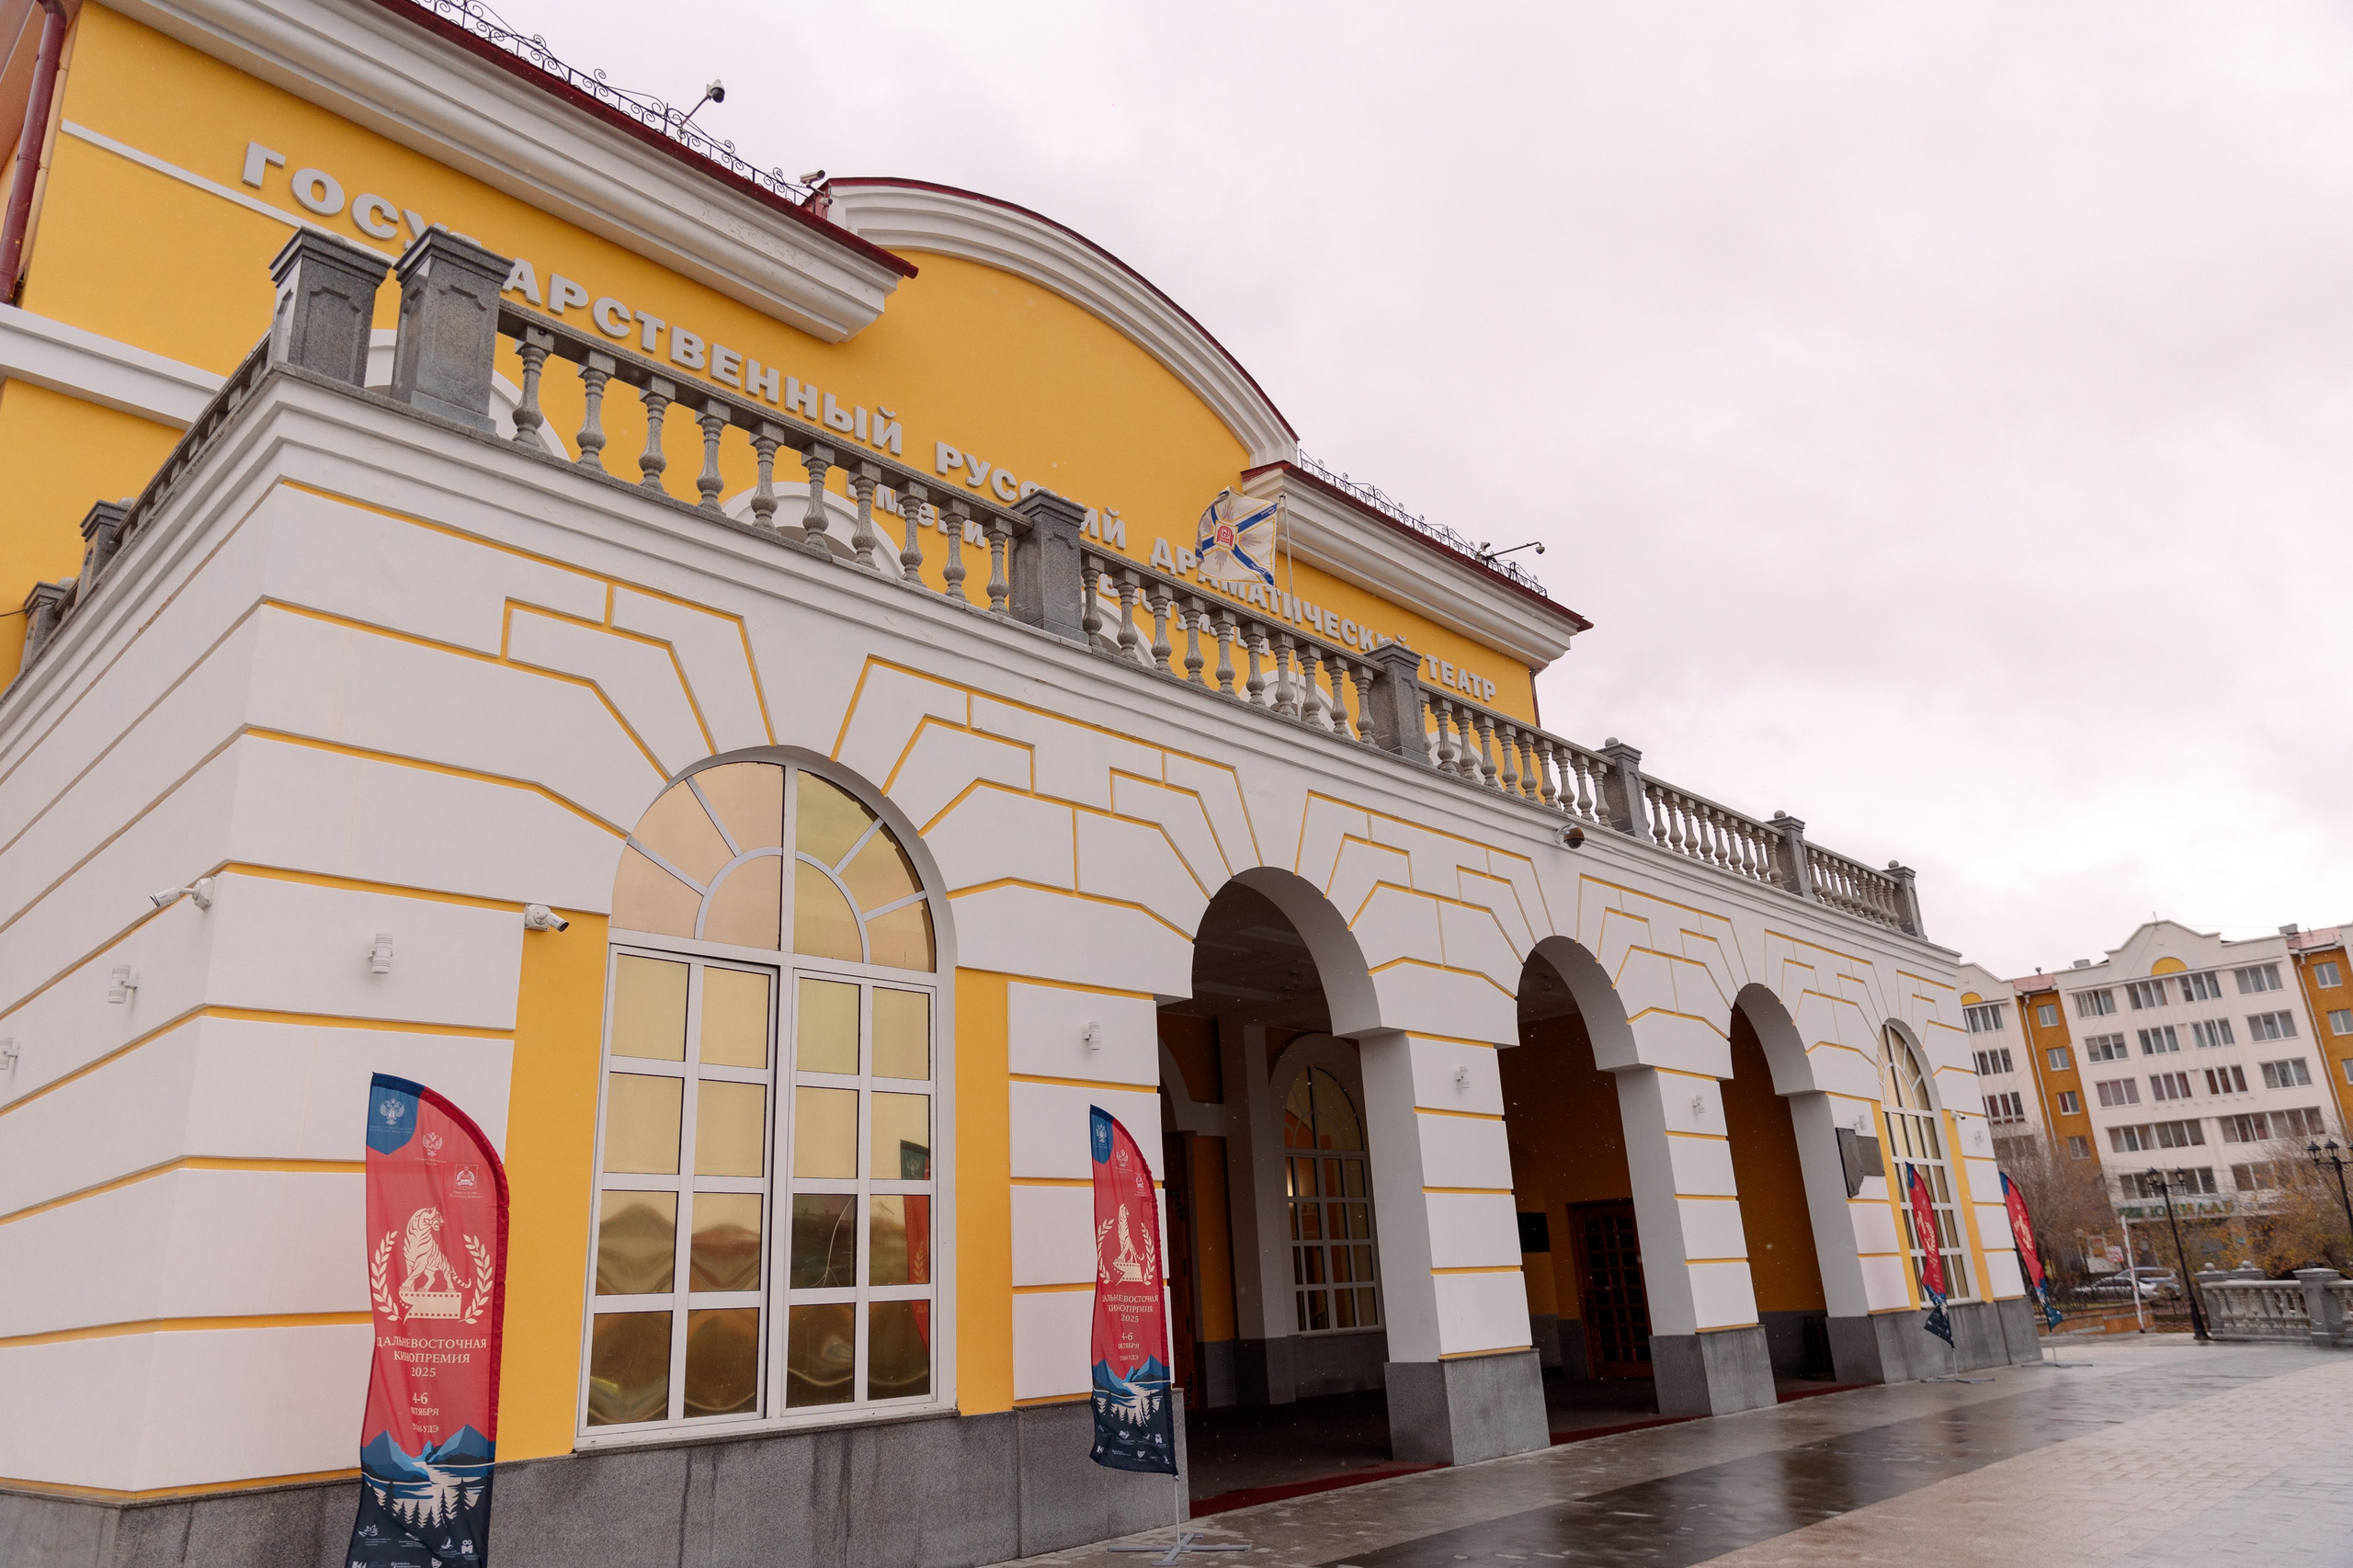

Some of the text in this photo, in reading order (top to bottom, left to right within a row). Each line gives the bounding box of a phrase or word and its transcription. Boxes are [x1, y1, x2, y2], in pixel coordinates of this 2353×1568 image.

[241, 141, 903, 457] ГОСУАРСТВЕННЫЙ
[936, 440, 1127, 551] РУСИЙ
[1150, 537, 1411, 652] ДРМАТИЧЕСК
[1424, 653, 1497, 702] ТЕАТР
[1120, 1313, 1140, 1323] 2025
[377, 1336, 487, 1349] ДАЛЬНЕВОСТОЧНАЯ
[393, 1350, 471, 1364] КИНОПРЕМИЯ
[411, 1367, 437, 1378] 2025
[412, 1392, 429, 1404] 4-6
